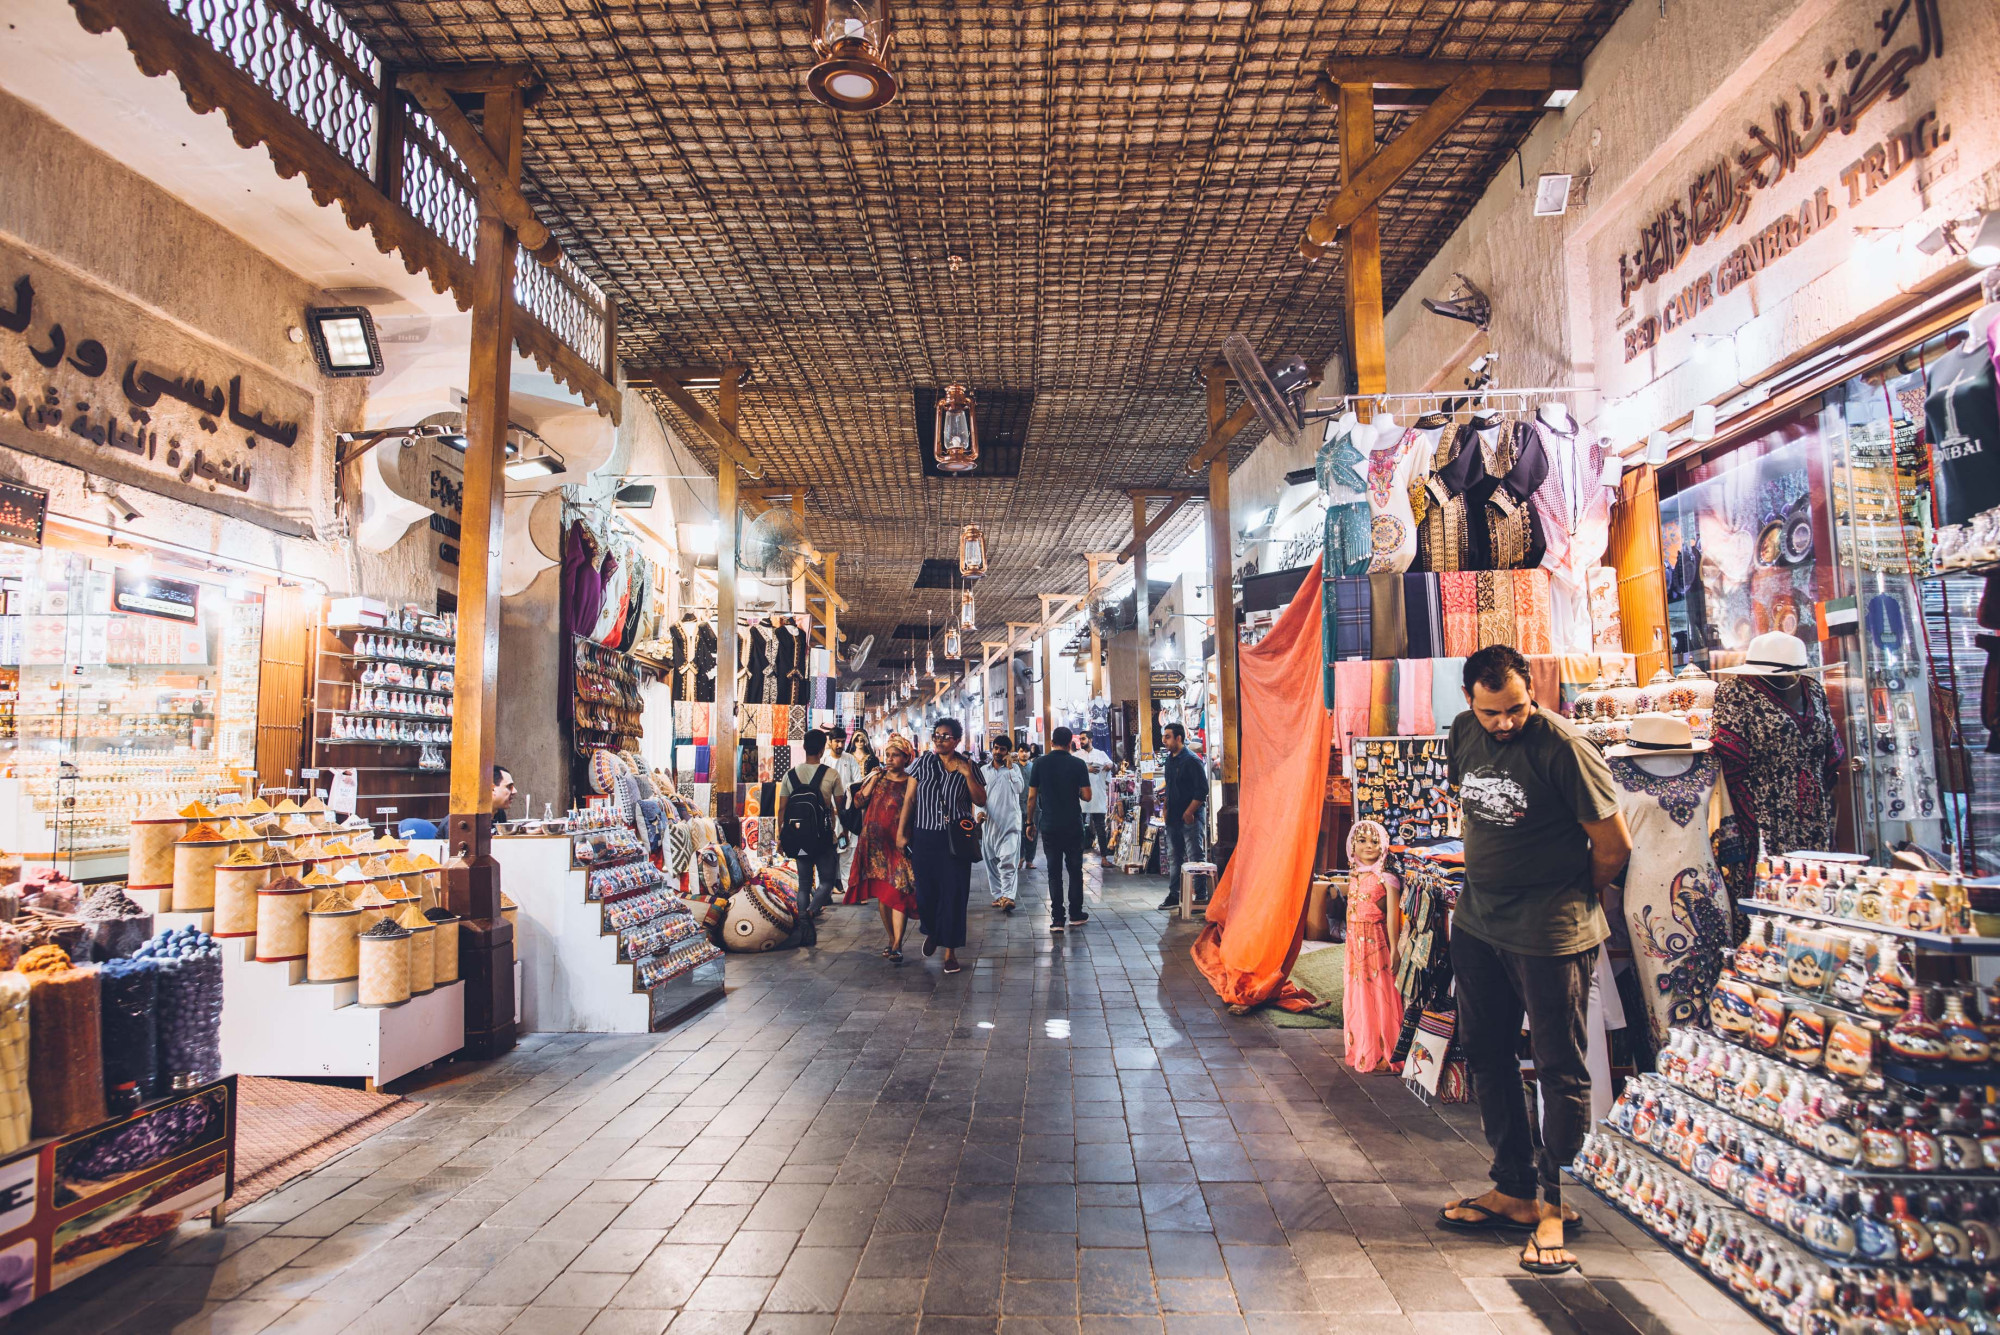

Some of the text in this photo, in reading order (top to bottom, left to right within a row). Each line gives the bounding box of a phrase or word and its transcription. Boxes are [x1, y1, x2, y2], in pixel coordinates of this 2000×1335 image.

[1624, 110, 1951, 364] RED CAVE GENERAL TRDG.
[70, 400, 157, 461] العامة
[1936, 438, 1983, 463] DUBAI
[260, 788, 284, 796] LEMON
